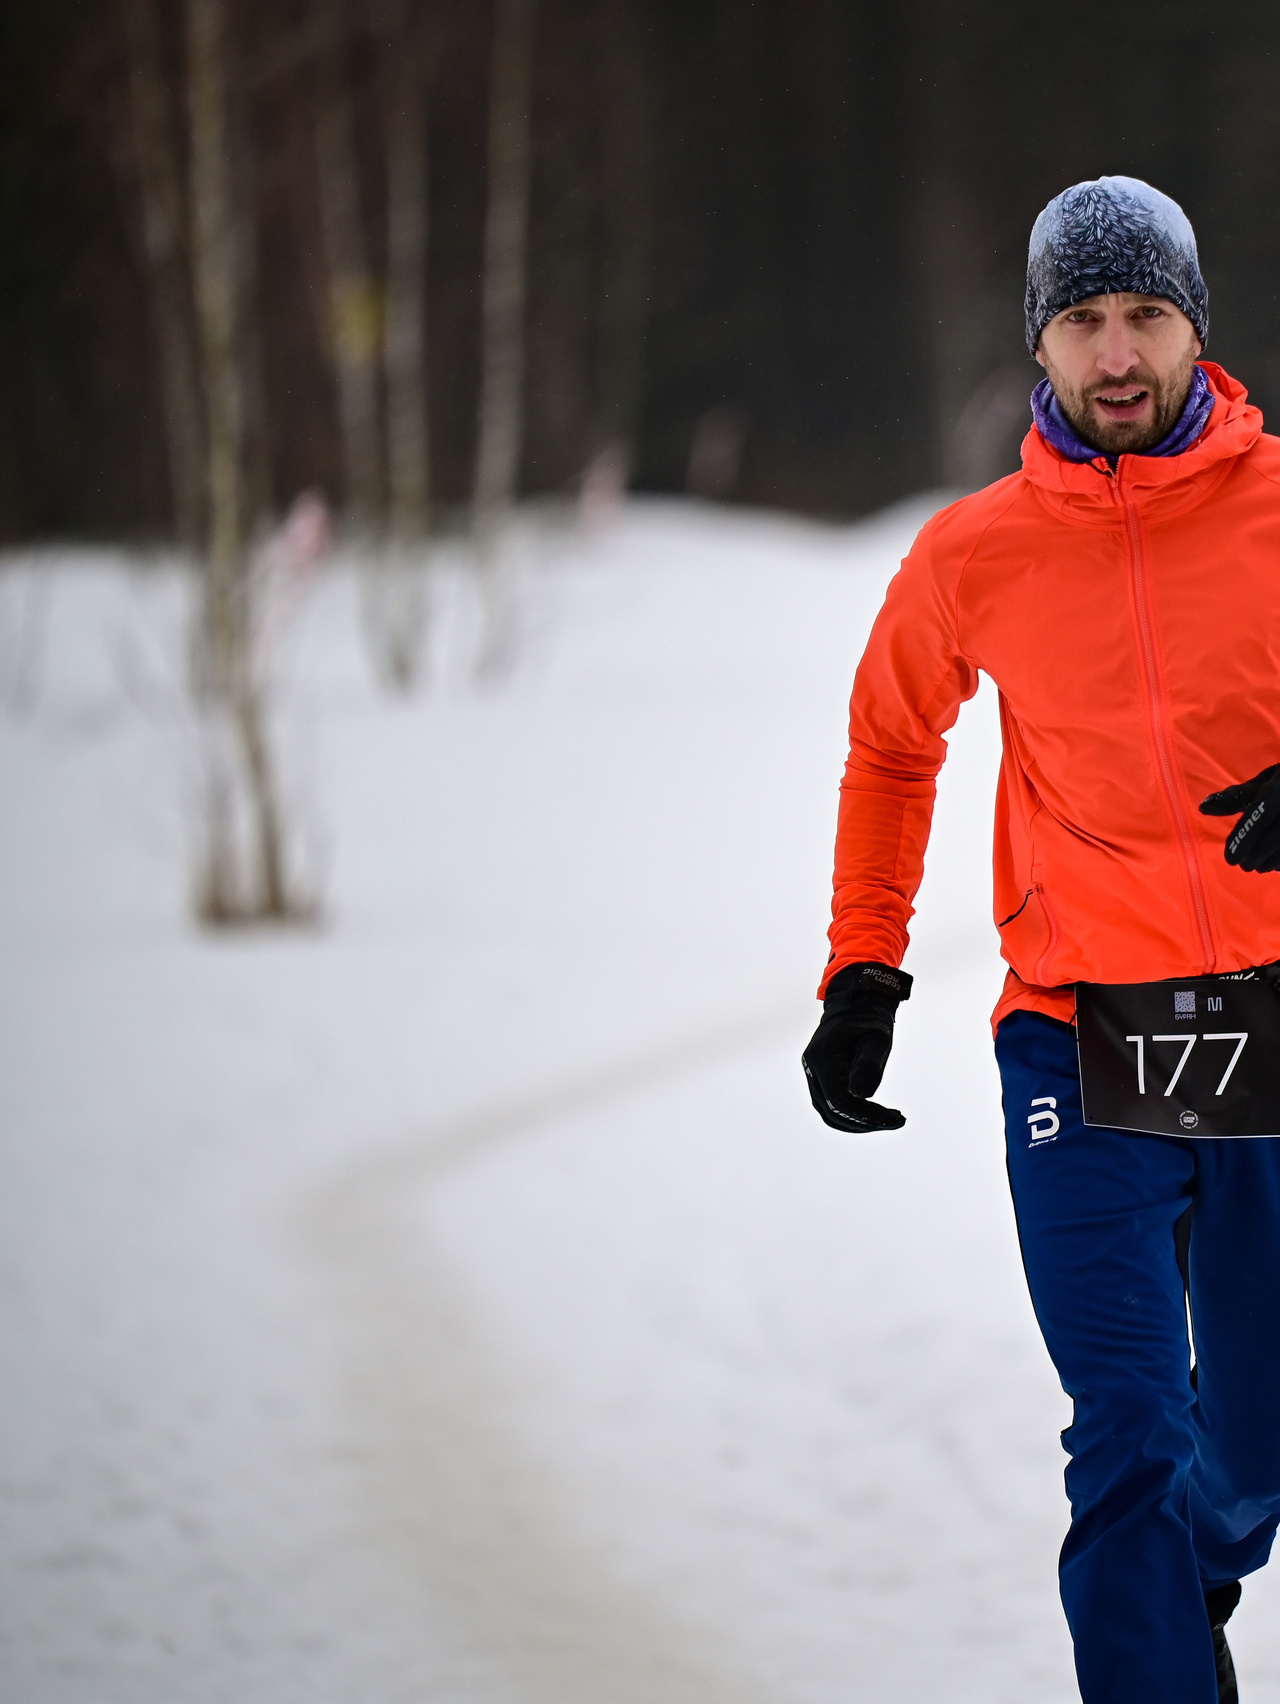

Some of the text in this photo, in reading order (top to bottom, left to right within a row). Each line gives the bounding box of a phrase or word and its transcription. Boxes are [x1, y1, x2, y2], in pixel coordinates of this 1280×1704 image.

[1229, 801, 1265, 854] ziener
[862, 968, 900, 983] nordic
[1126, 1032, 1248, 1097] 177
